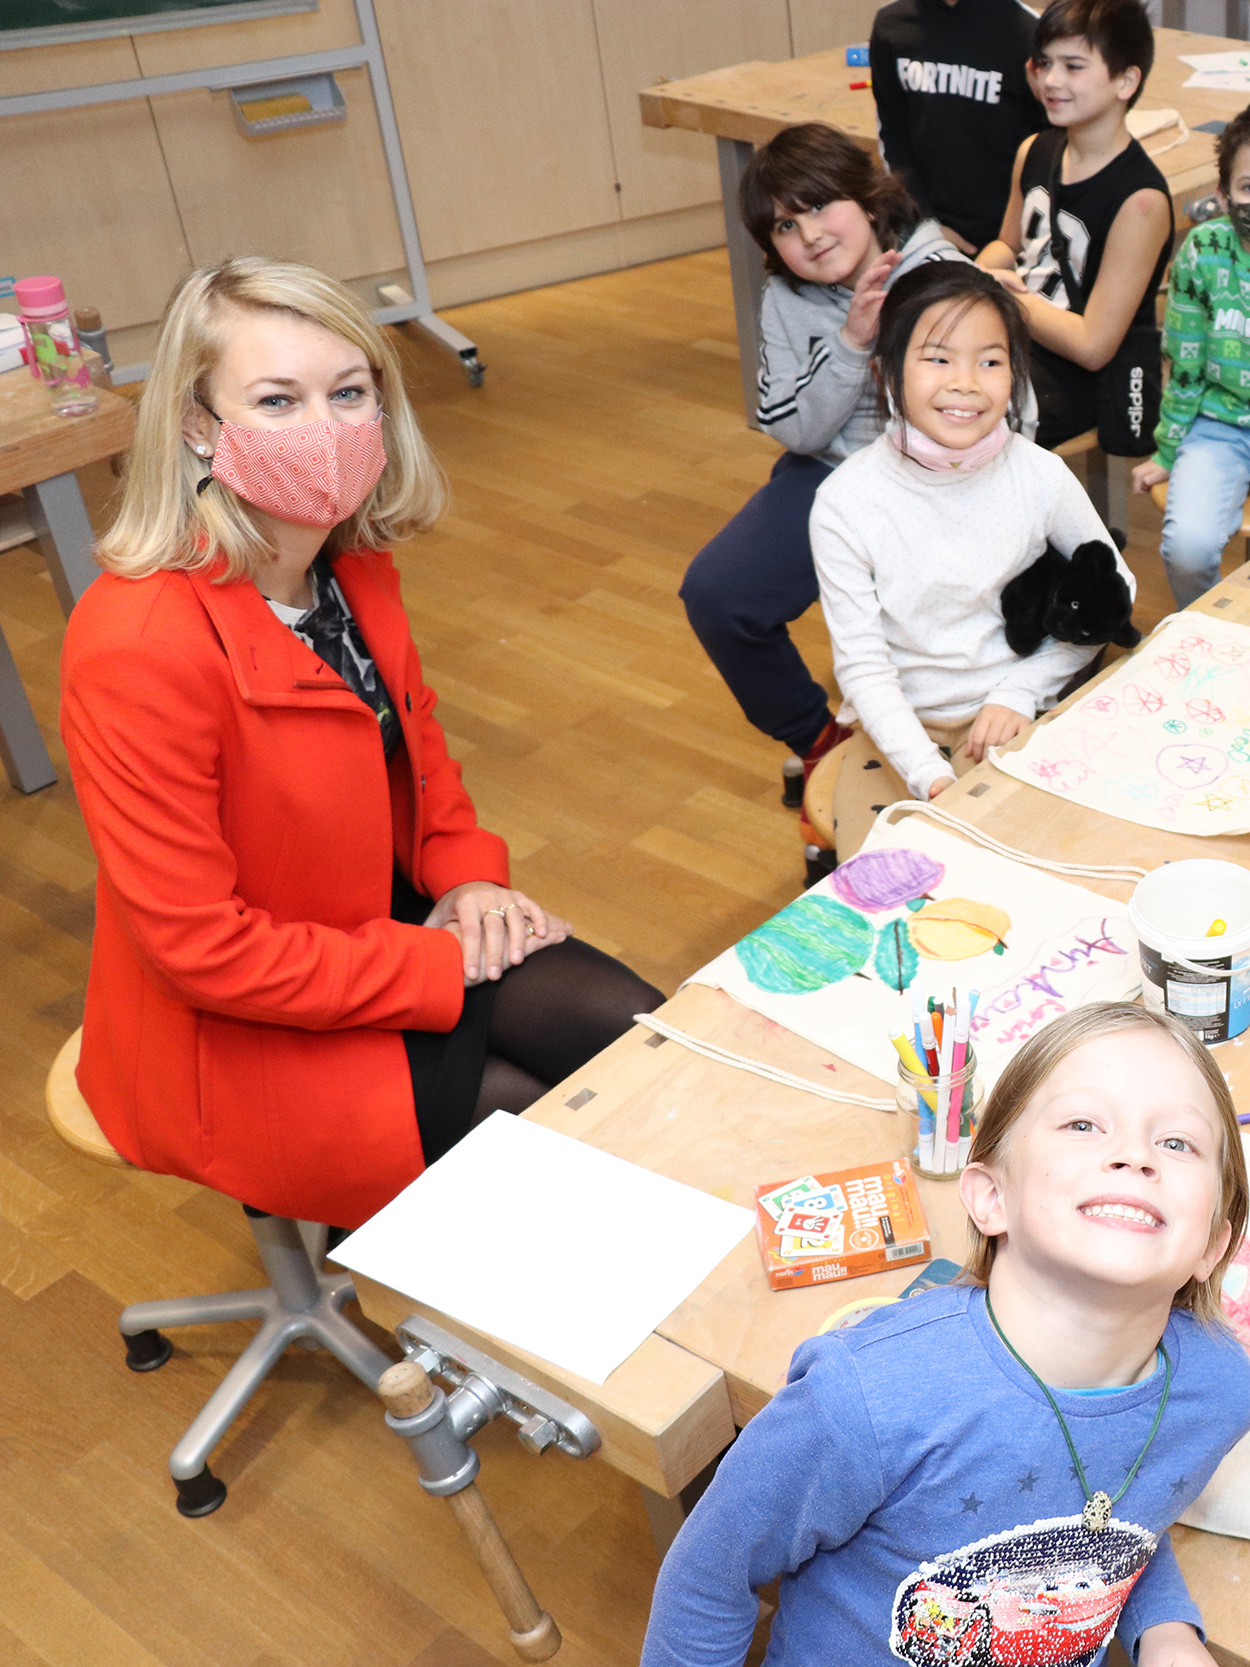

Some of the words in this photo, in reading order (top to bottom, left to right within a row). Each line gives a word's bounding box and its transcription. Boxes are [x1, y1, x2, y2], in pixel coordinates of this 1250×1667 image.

[897, 57, 1003, 105] FORTNITE
[863, 1175, 890, 1215] mau
[812, 1262, 840, 1274] mau
